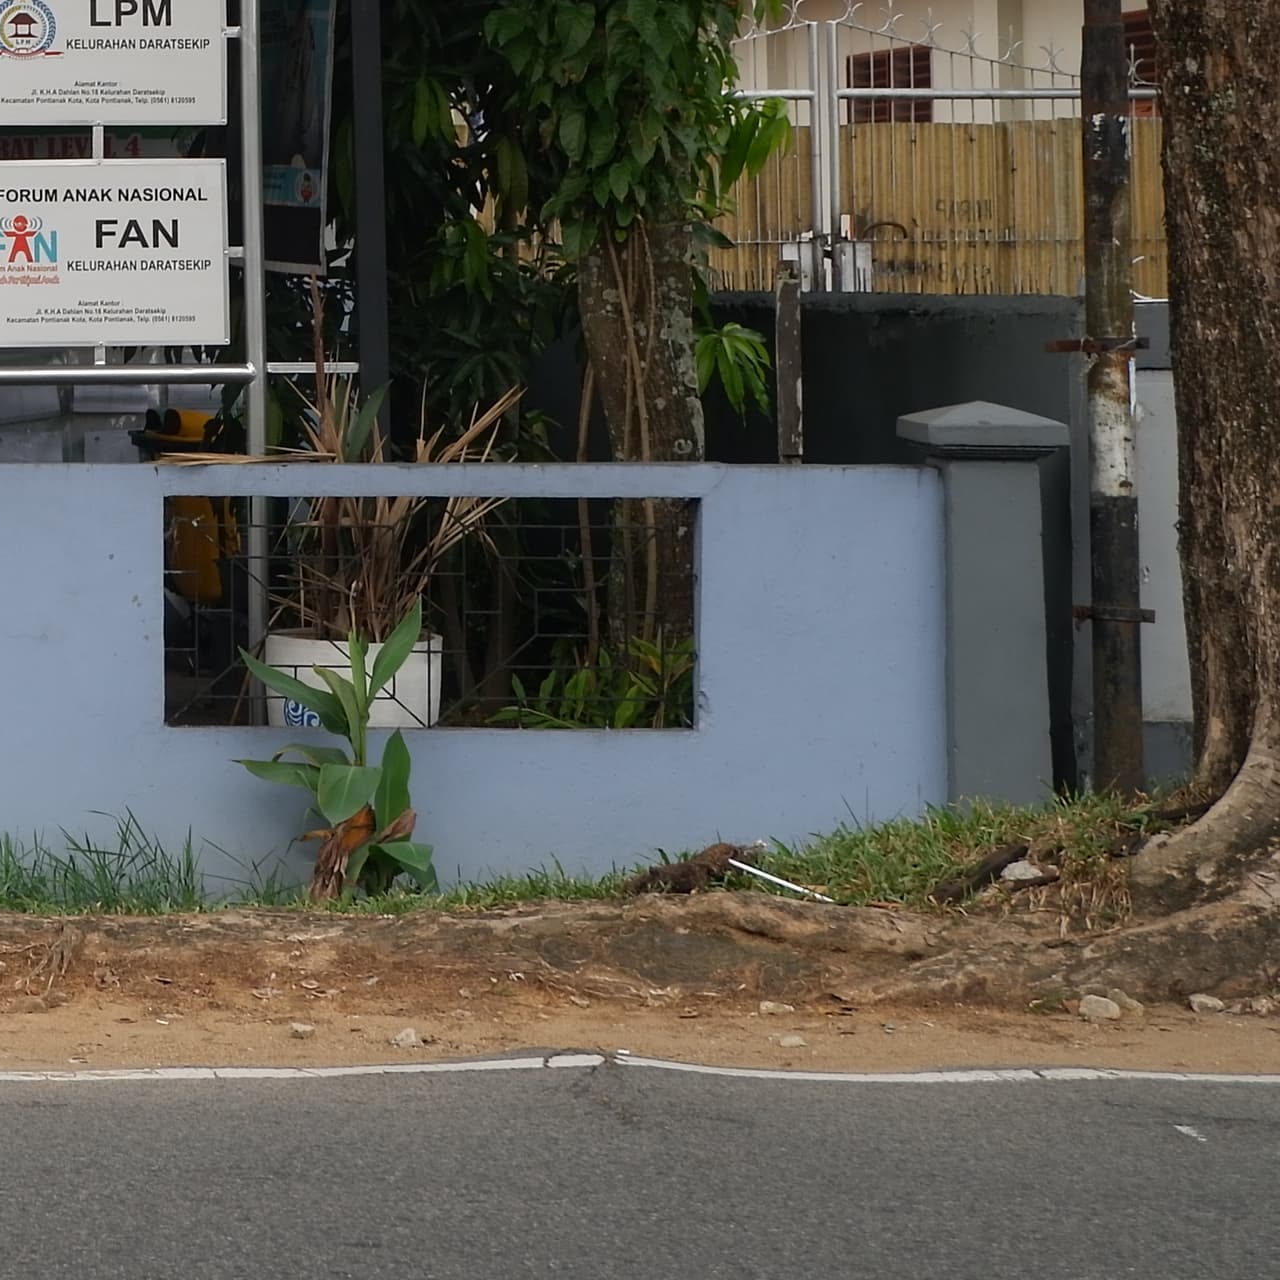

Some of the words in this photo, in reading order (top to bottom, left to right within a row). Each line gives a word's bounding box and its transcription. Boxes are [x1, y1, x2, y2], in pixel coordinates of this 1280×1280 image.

[62, 188, 112, 202] ANAK
[118, 187, 208, 202] NASIONAL
[95, 219, 178, 248] FAN
